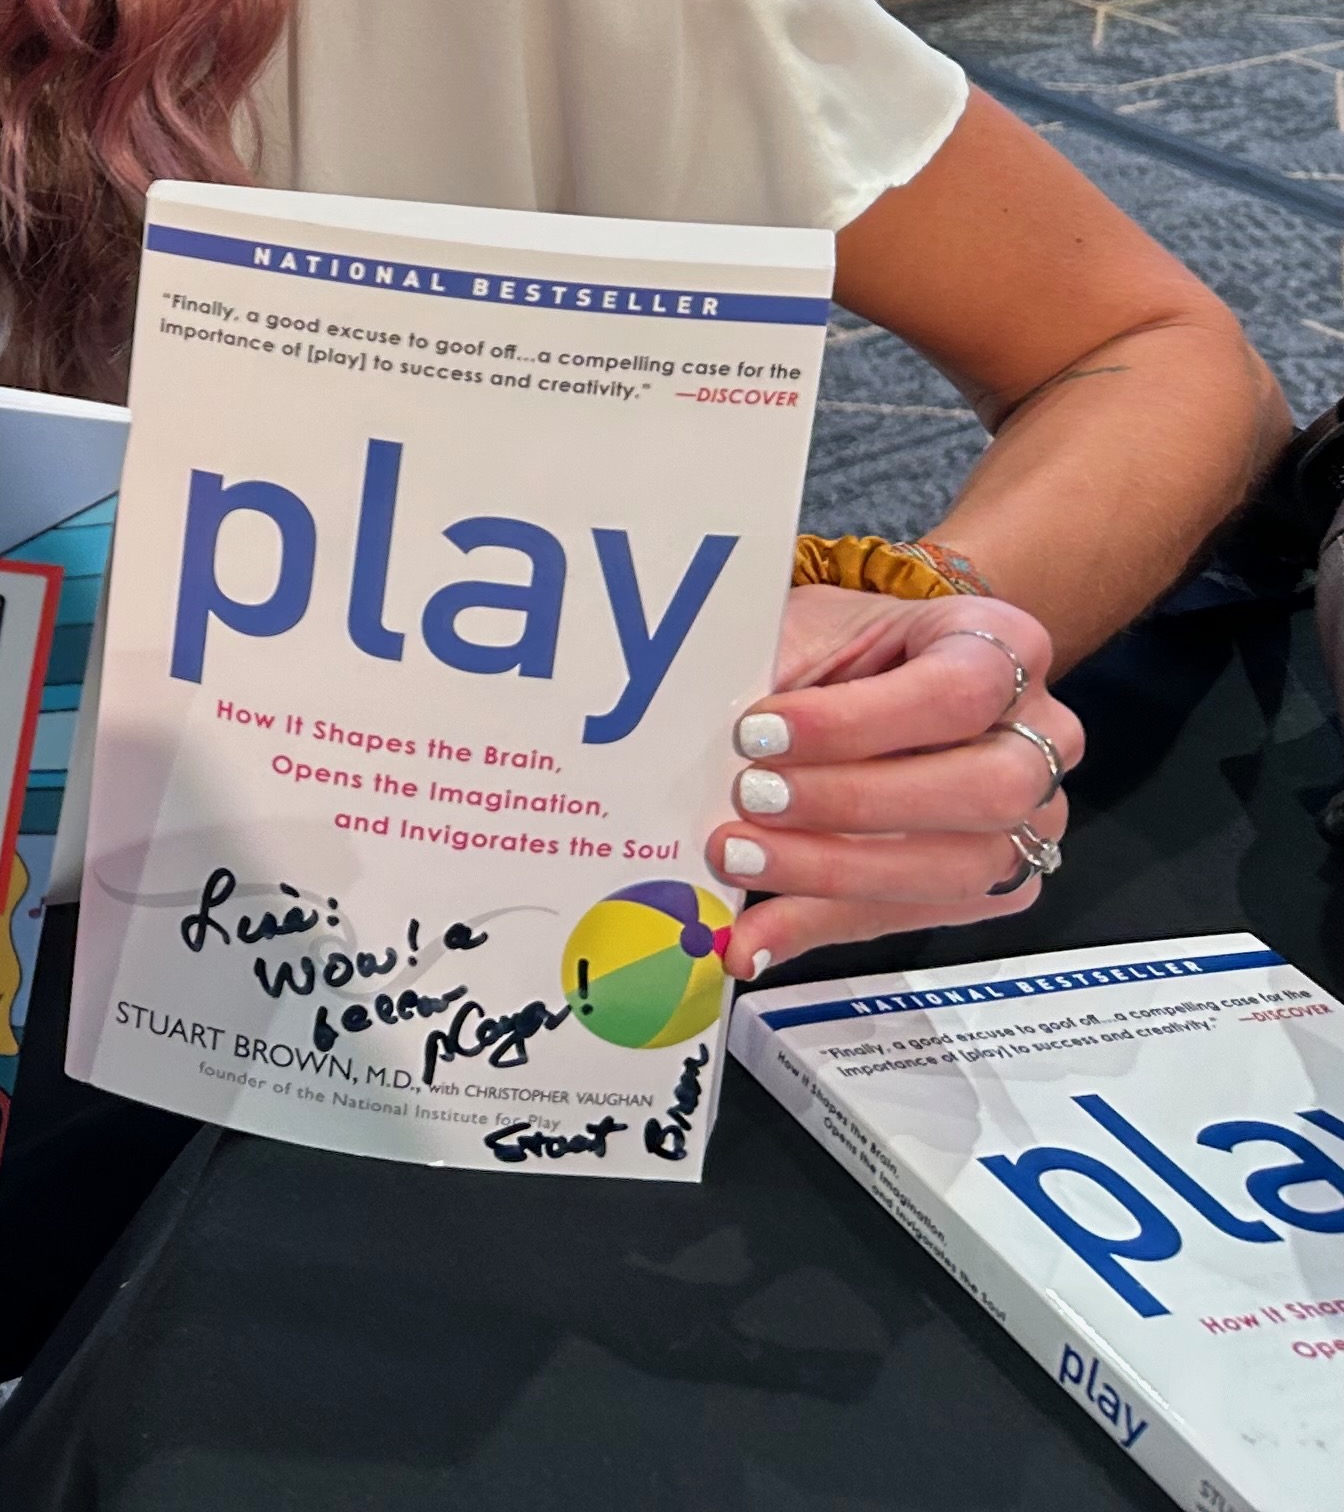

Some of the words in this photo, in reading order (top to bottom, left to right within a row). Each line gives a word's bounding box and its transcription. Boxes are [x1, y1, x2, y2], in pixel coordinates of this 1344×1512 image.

[252, 245, 446, 292] NATIONAL
[471, 277, 719, 317] BESTSELLER
[159, 317, 275, 353] importance
[281, 343, 302, 358] of
[307, 344, 367, 372] [play]
[373, 355, 394, 372] to
[399, 360, 483, 385] success
[490, 370, 531, 389] and
[246, 308, 260, 324] a
[264, 313, 320, 335] good
[326, 322, 401, 346] excuse
[408, 331, 429, 350] to
[435, 338, 485, 357] goof
[558, 350, 675, 376] compelling
[681, 361, 730, 376] case
[736, 361, 764, 379] for
[769, 363, 802, 381] the
[169, 437, 741, 745] play
[216, 699, 276, 729] How
[285, 714, 304, 737] It
[312, 720, 417, 755] Shapes
[427, 738, 473, 763] the
[483, 745, 563, 775] Brain,
[271, 754, 363, 789] Opens
[373, 772, 418, 798] the
[429, 781, 610, 819] Imagination,
[333, 811, 390, 836] and
[399, 818, 560, 855] Invigorates
[569, 836, 613, 858] the
[622, 838, 681, 861] Soul
[850, 985, 1005, 1016] NATIONAL
[1014, 960, 1204, 994] BESTSELLER
[892, 1039, 906, 1051] a
[907, 1032, 954, 1051] good
[956, 1025, 1016, 1043] excuse
[1015, 1022, 1036, 1035] to
[1037, 1016, 1078, 1034] goof
[1129, 999, 1221, 1020] compelling
[1219, 994, 1260, 1009] case
[1257, 990, 1282, 1005] for
[1280, 988, 1313, 1001] the
[115, 1000, 226, 1052] STUART
[232, 1033, 360, 1086] BROWN,
[429, 1081, 461, 1096] with
[463, 1084, 570, 1105] CHRISTOPHER
[575, 1091, 655, 1108] VAUGHAN
[940, 1051, 960, 1064] of
[958, 1044, 1012, 1065] [play]
[1010, 1042, 1031, 1056] to
[1031, 1033, 1099, 1053] success
[1099, 1028, 1134, 1043] and
[198, 1060, 268, 1089] founder
[272, 1081, 292, 1096] of
[296, 1086, 326, 1104] the
[331, 1090, 409, 1118] National
[415, 1104, 489, 1126] Institute
[527, 1114, 562, 1133] Play
[976, 1092, 1344, 1319] pla
[1198, 1313, 1261, 1335] How
[1257, 1305, 1287, 1324] It
[1058, 1342, 1151, 1449] play
